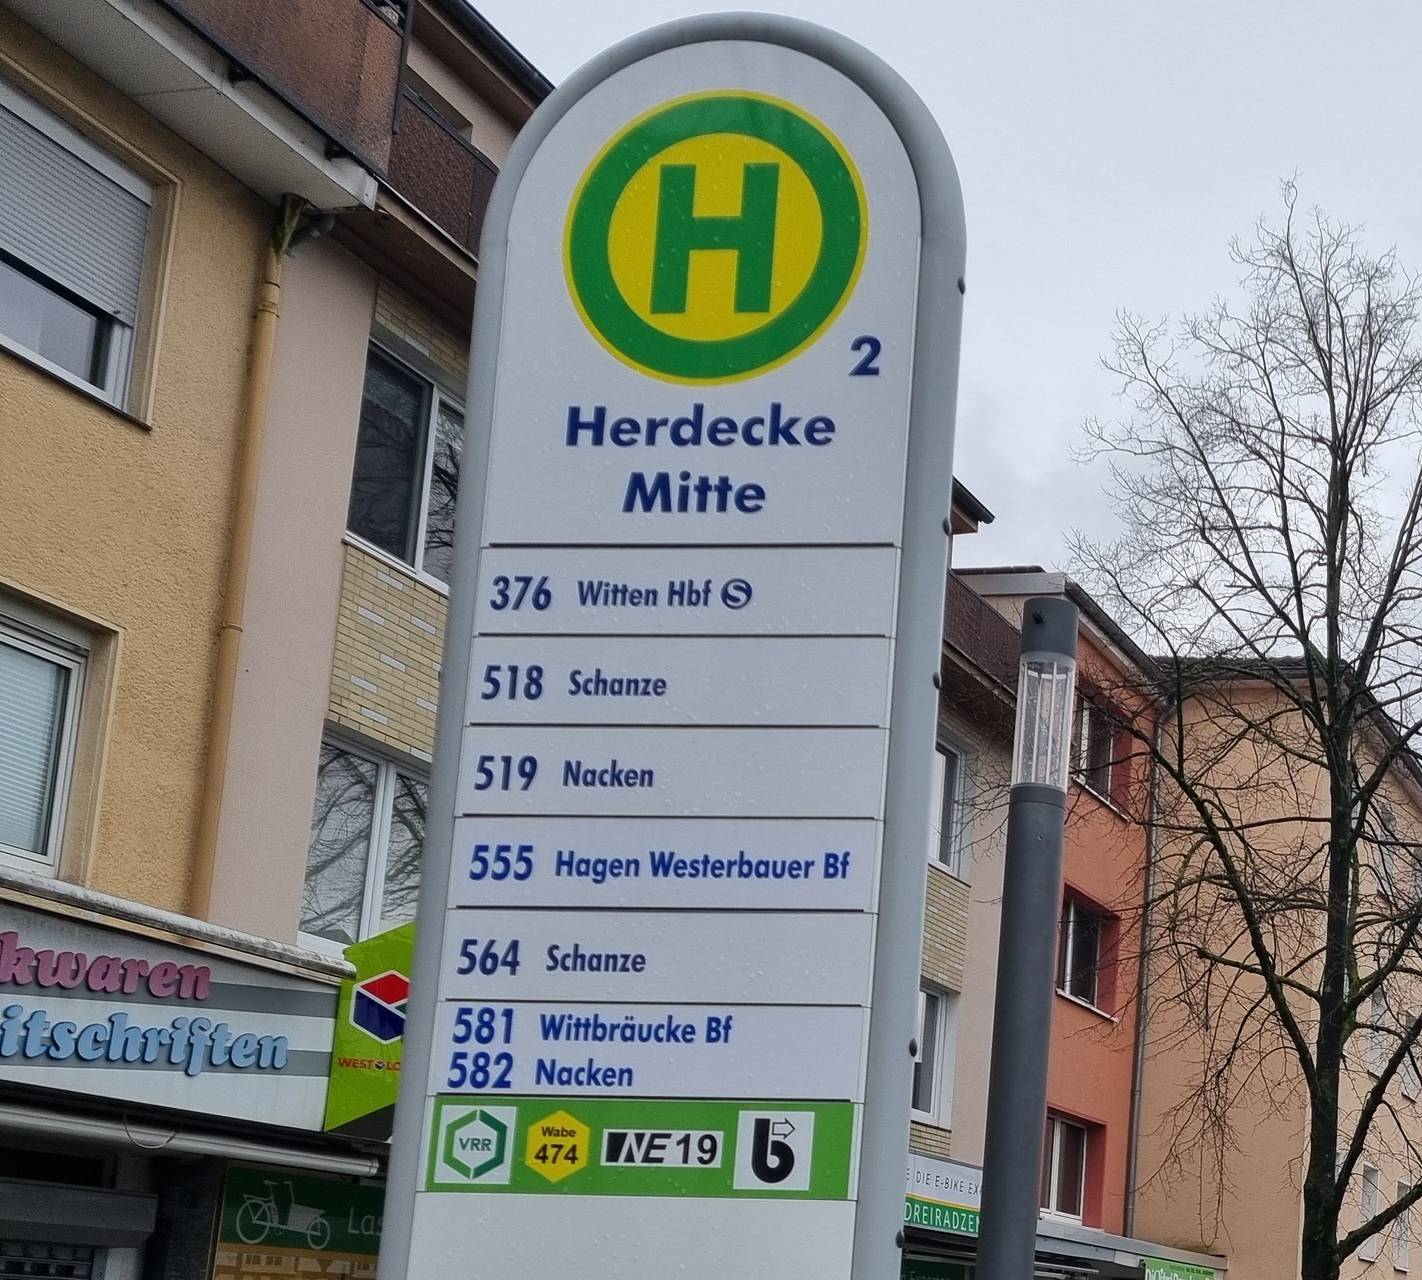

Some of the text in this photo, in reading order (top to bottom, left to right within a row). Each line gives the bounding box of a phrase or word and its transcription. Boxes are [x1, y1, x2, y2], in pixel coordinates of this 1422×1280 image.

[650, 162, 780, 314] H
[848, 335, 882, 377] 2
[565, 402, 836, 447] Herdecke
[622, 470, 766, 514] Mitte
[490, 575, 552, 611] 376
[577, 579, 659, 607] Witten
[667, 579, 713, 607] Hbf
[481, 665, 667, 701] 518 Schanze
[474, 755, 654, 791] 519 Nacken
[469, 844, 851, 885] 555 Hagen Westerbauer Bf
[456, 938, 646, 976] 564 Schanze
[452, 1007, 733, 1045] 581 Wittbräucke Bf
[336, 1057, 374, 1069] WEST
[447, 1051, 633, 1090] 582 Nacken
[458, 1137, 492, 1152] VRR
[541, 1126, 577, 1138] Wabe
[533, 1143, 579, 1165] 474
[916, 1171, 930, 1185] DIE
[934, 1175, 964, 1193] E-BIKE
